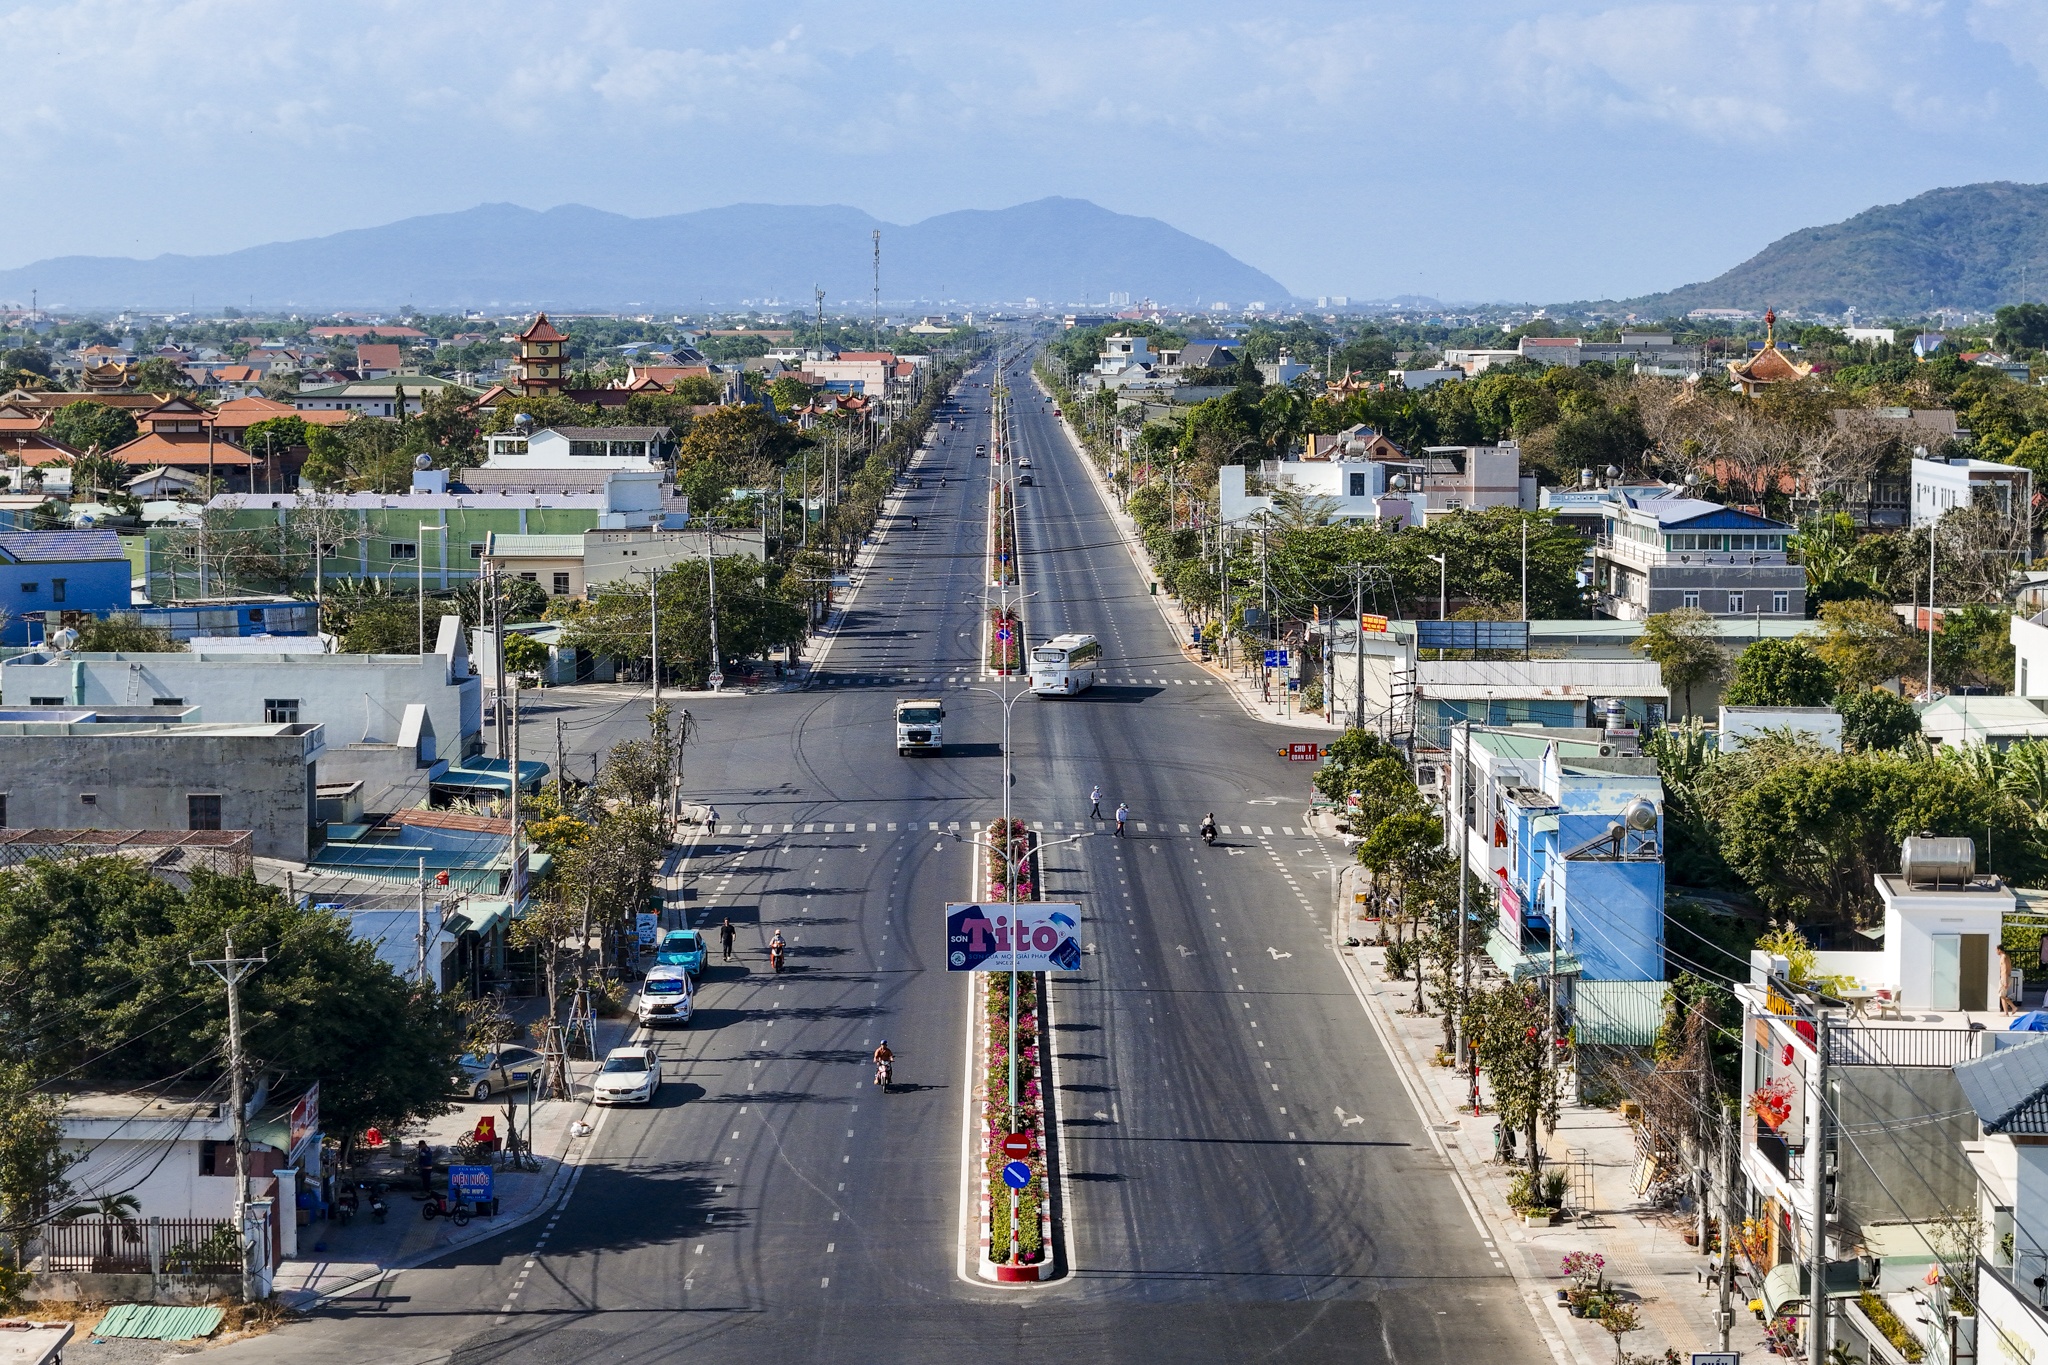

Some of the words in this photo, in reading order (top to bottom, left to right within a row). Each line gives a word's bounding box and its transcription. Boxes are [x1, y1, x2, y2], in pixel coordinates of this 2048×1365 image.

[951, 935, 968, 943] SƠN
[452, 1172, 469, 1188] ĐIỆN
[470, 1172, 490, 1186] NƯỚC
